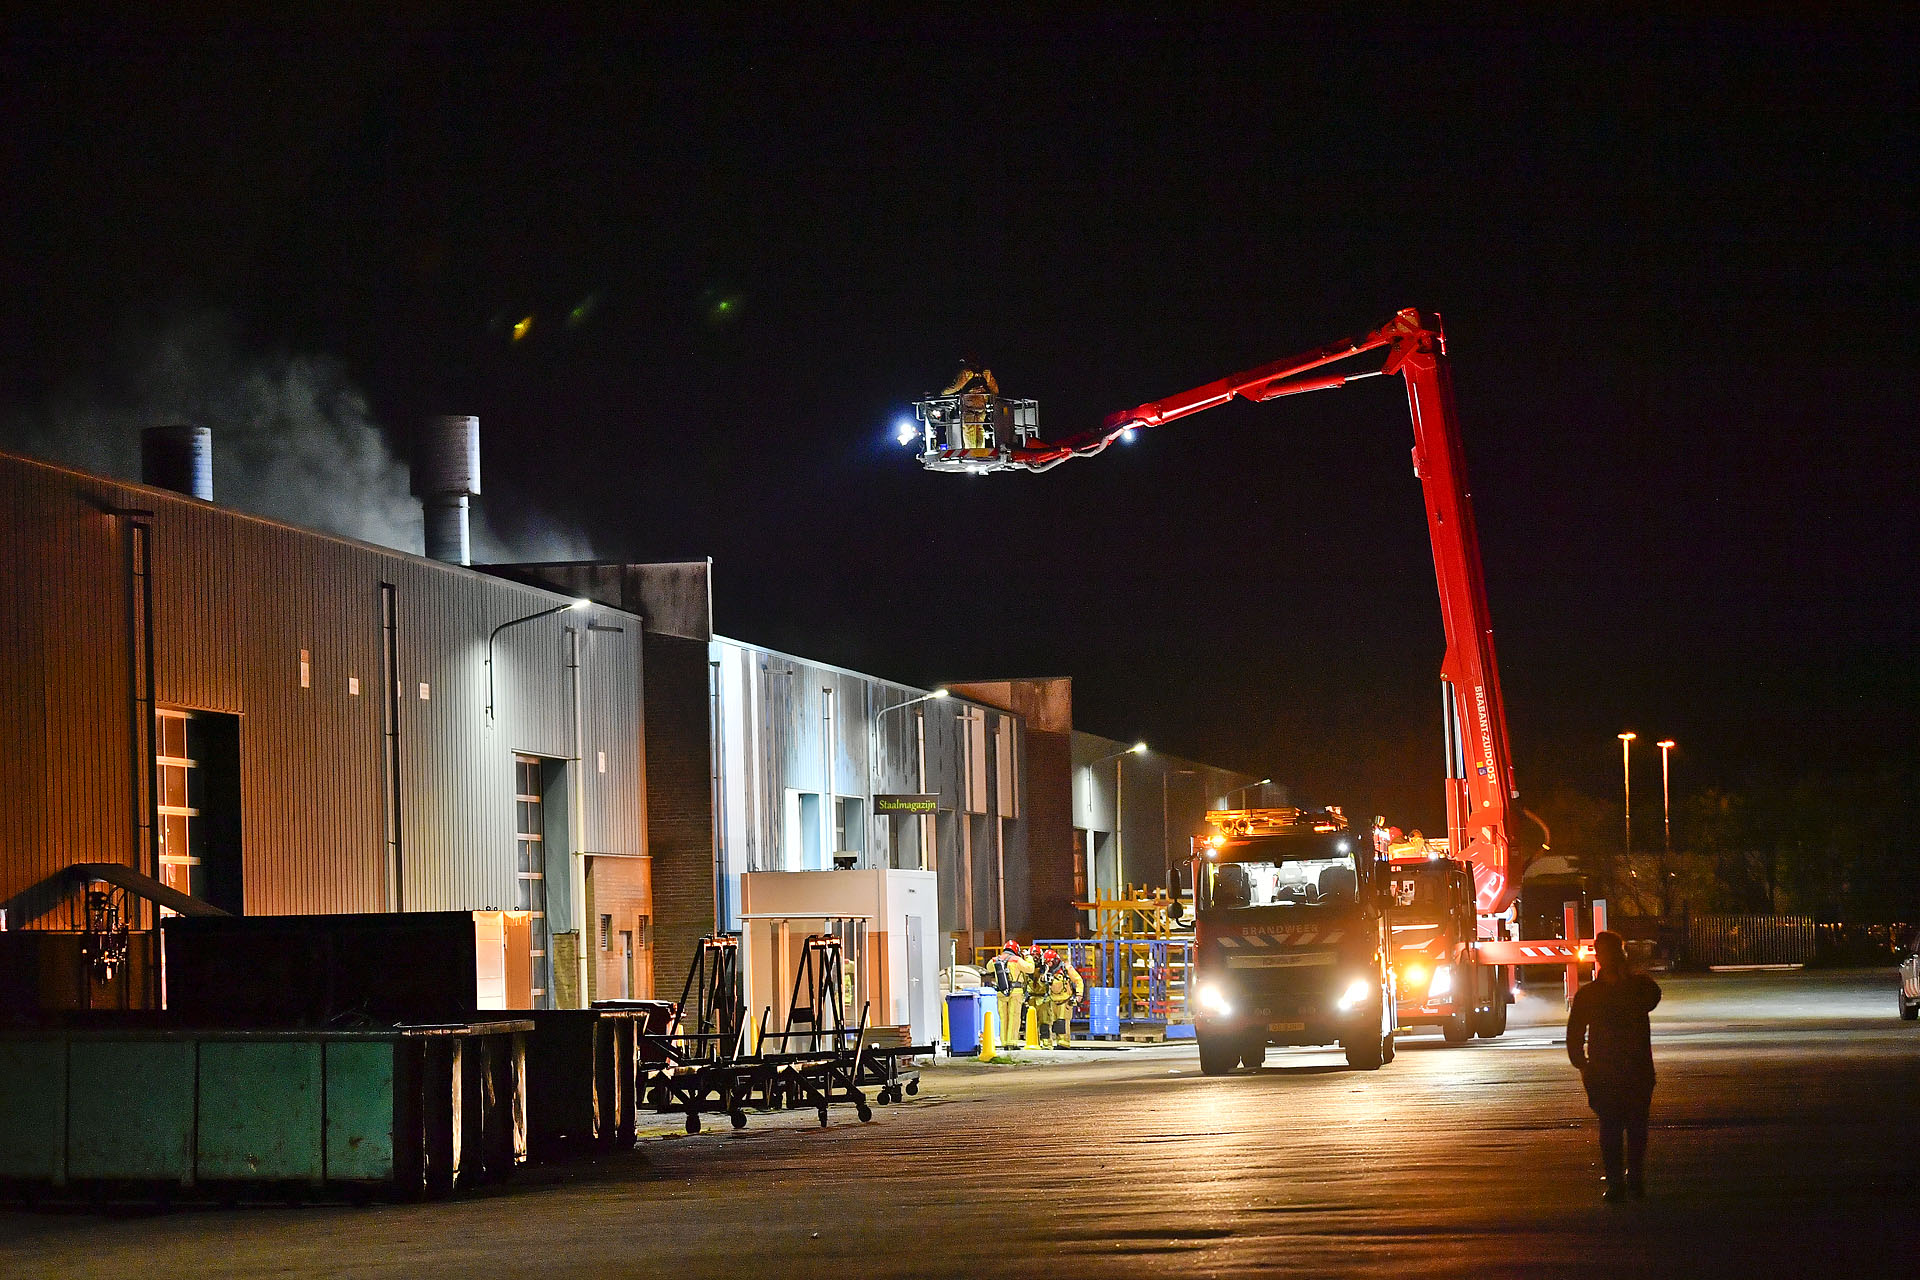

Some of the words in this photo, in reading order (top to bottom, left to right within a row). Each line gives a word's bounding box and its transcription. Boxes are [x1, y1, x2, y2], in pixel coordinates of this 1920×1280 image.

[1474, 685, 1496, 785] BRABANT-ZUIDOOST
[879, 798, 937, 812] Staalmagazijn
[1242, 924, 1320, 936] BRANDWEER
